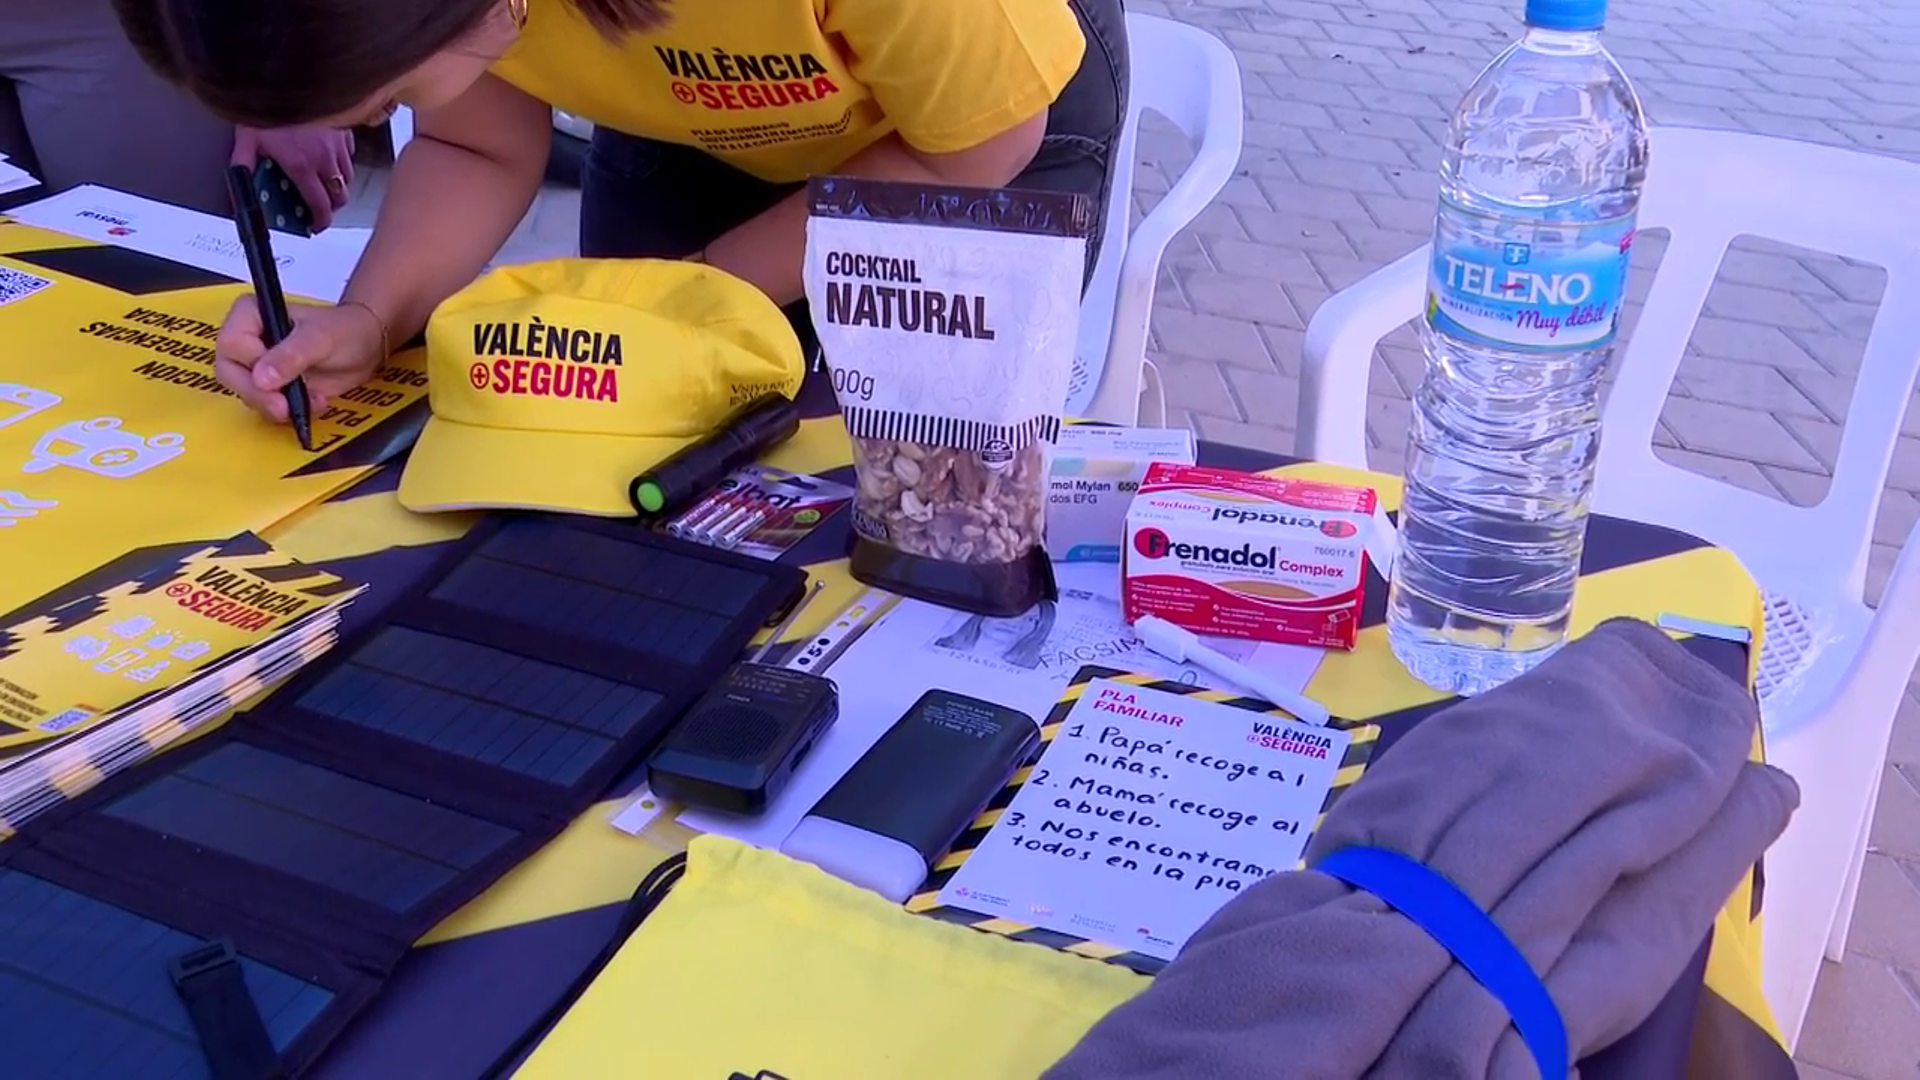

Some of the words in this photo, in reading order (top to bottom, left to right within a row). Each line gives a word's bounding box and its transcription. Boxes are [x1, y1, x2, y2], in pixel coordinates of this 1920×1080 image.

[654, 45, 828, 82] VALÈNCIA
[695, 76, 840, 111] SEGURA
[825, 250, 922, 284] COCKTAIL
[1444, 254, 1593, 306] TELENO
[826, 281, 996, 341] NATURAL
[1515, 309, 1561, 338] Muy
[1565, 301, 1608, 328] débil
[79, 321, 217, 367] MERGENCIAS
[473, 316, 624, 366] VALÈNCIA
[491, 358, 619, 403] SEGURA
[829, 367, 876, 402] 00g
[1073, 494, 1098, 505] EFG
[1075, 479, 1112, 494] Mylan
[1117, 481, 1140, 493] 650
[1210, 508, 1342, 537] Frenadol
[1148, 533, 1278, 570] Frenadol
[1278, 560, 1345, 578] Complex
[194, 564, 310, 617] VALÈNCIA
[177, 589, 278, 633] SEGURA
[1038, 636, 1146, 669] FACSIM
[1093, 700, 1184, 727] FAMILIAR
[1100, 689, 1136, 704] PLA
[1252, 721, 1333, 750] VALÈNCIA
[1261, 736, 1328, 761] SEGURA
[1084, 752, 1170, 781] niñas.
[1098, 726, 1172, 757] Papá
[1174, 748, 1260, 783] recoge
[1031, 768, 1059, 789] 2.
[1068, 775, 1165, 806] Mamá
[1169, 798, 1259, 832] recoge
[1271, 819, 1300, 836] al
[1053, 796, 1162, 829] abuelo.
[1005, 811, 1027, 829] 3.
[1039, 819, 1100, 843] Nos
[1106, 835, 1278, 880] encontramo
[1011, 834, 1092, 862] todos
[1105, 854, 1139, 872] en
[1152, 863, 1186, 882] la
[1193, 873, 1243, 893] pla
